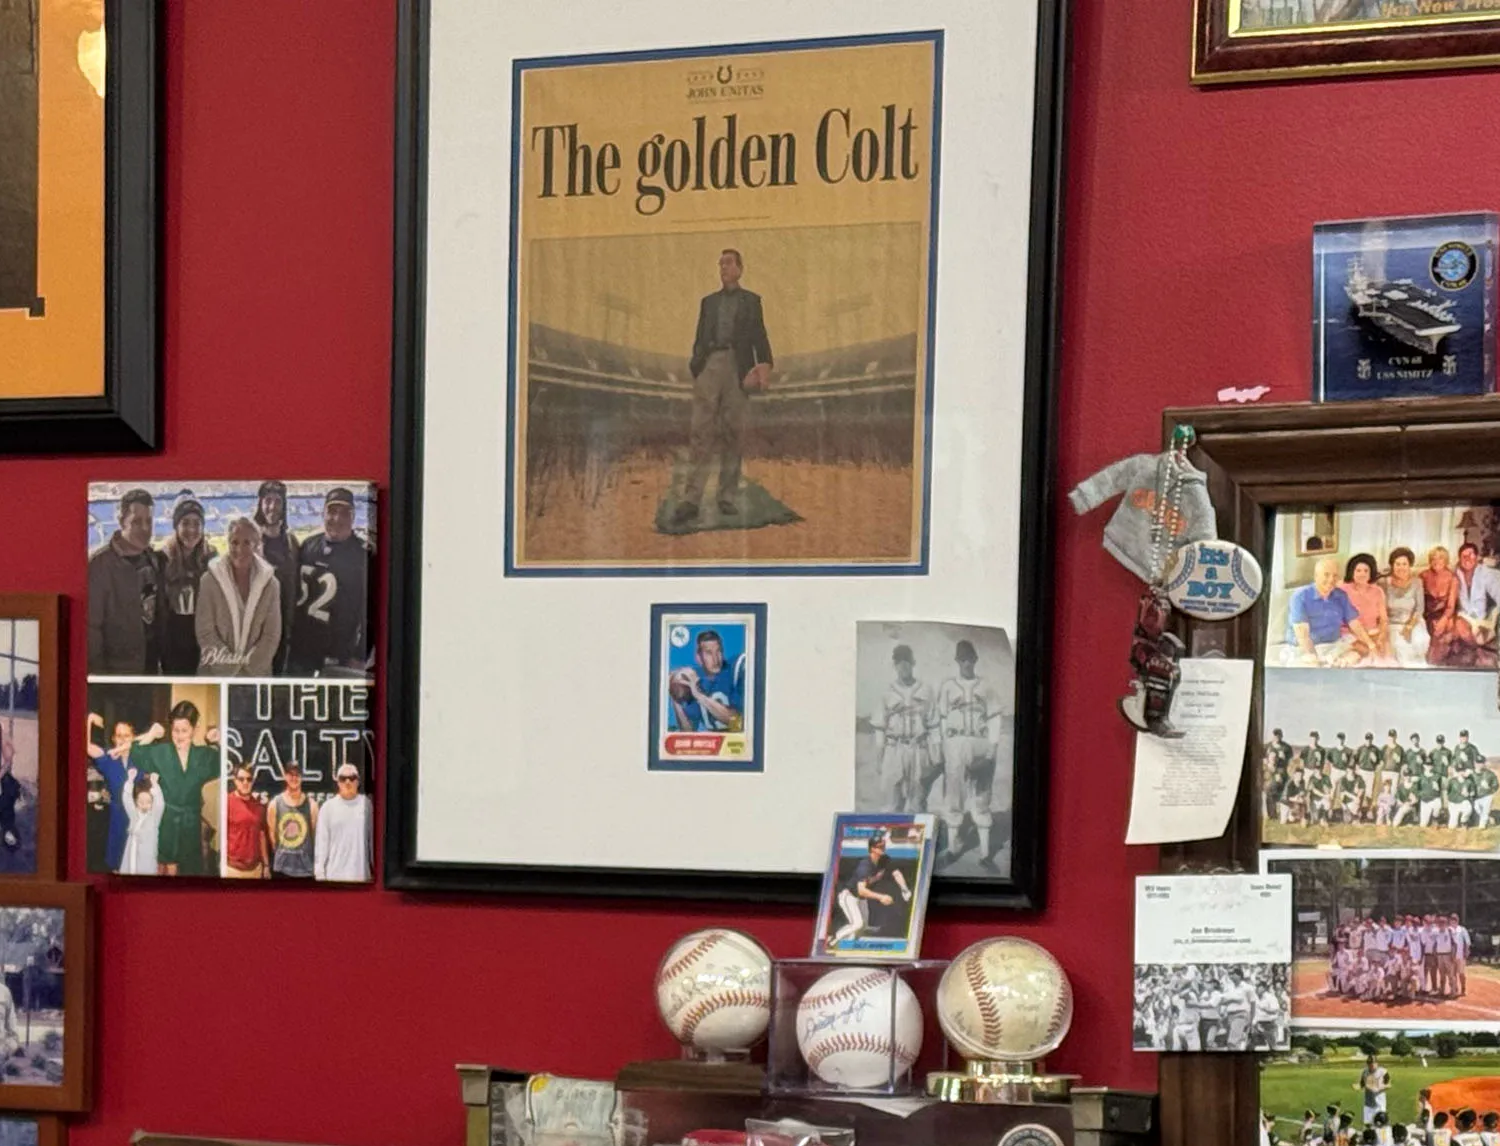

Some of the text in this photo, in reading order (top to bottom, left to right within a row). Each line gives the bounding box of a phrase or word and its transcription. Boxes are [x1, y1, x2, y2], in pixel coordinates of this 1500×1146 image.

[532, 103, 919, 216] The golden Colt
[1396, 369, 1434, 380] NIMITZ
[1187, 581, 1235, 599] BOY
